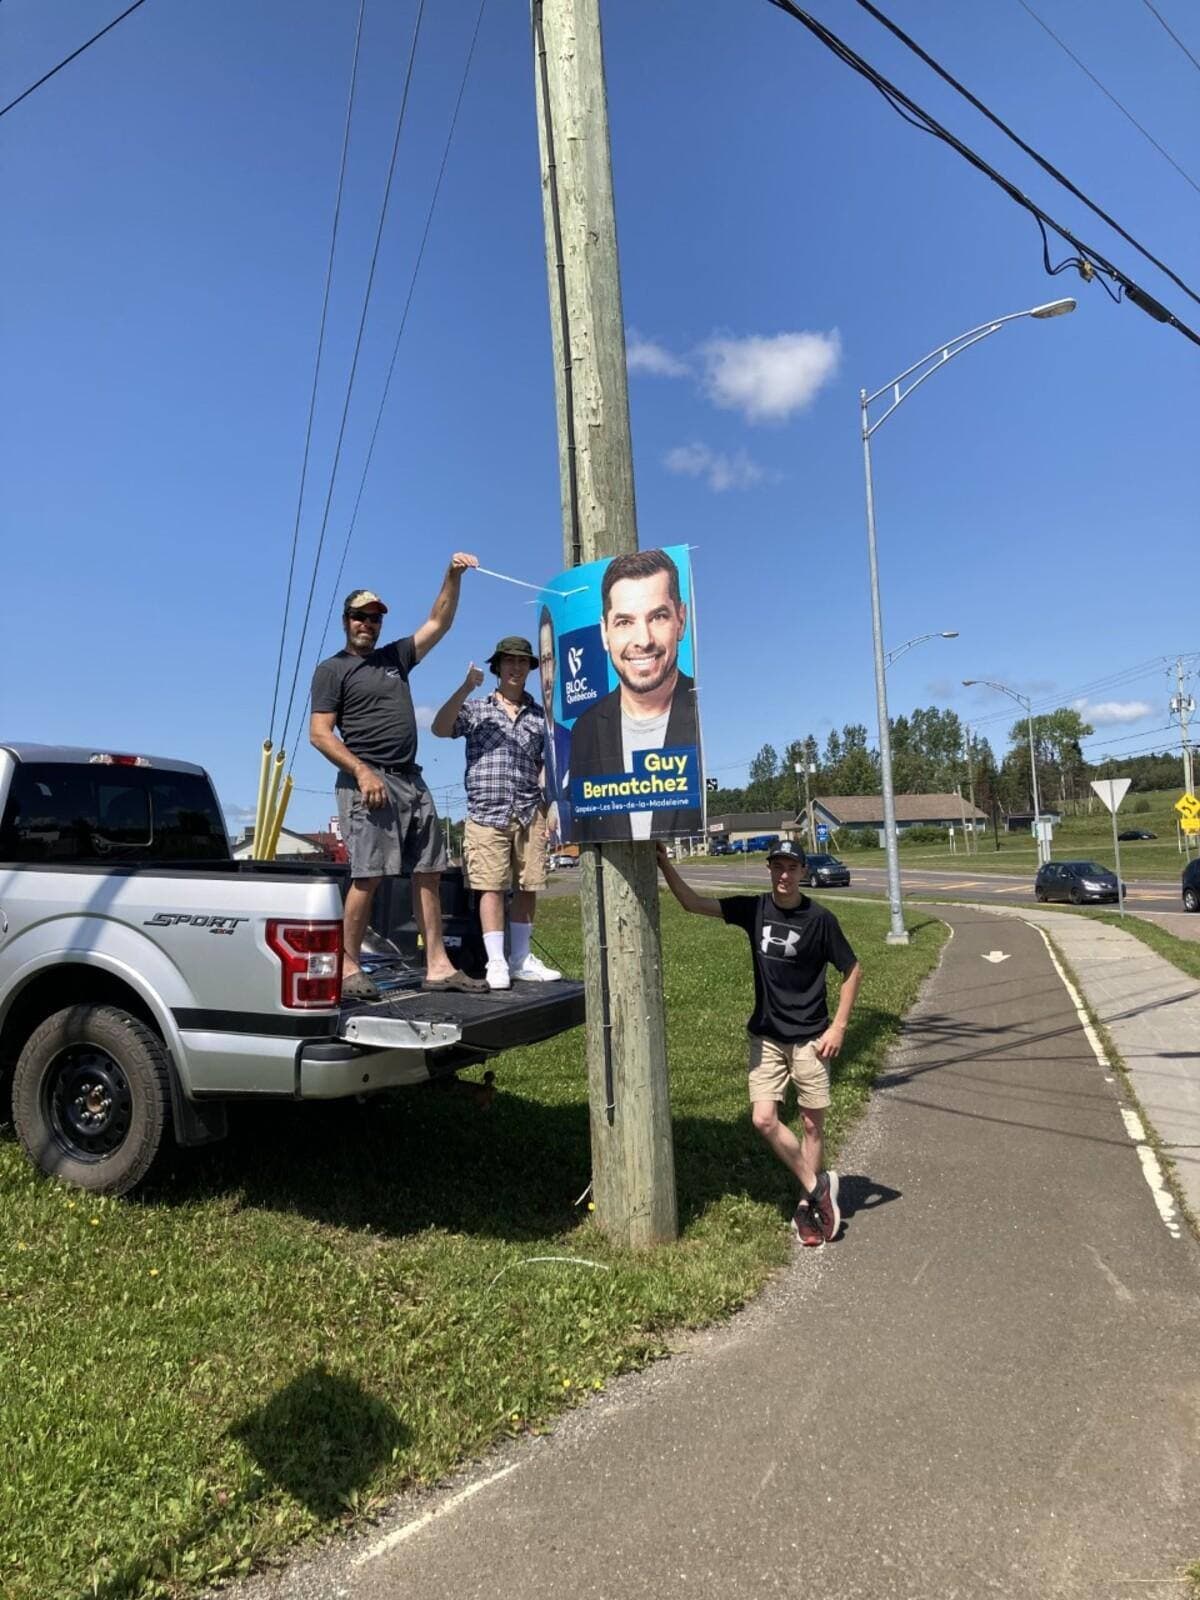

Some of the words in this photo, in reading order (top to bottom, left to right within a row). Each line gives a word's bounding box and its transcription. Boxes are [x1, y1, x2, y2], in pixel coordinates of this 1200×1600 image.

[565, 677, 588, 695] BLOC
[644, 753, 688, 775] Guy
[583, 775, 688, 799] Bernatchez
[143, 912, 250, 929] SPORT
